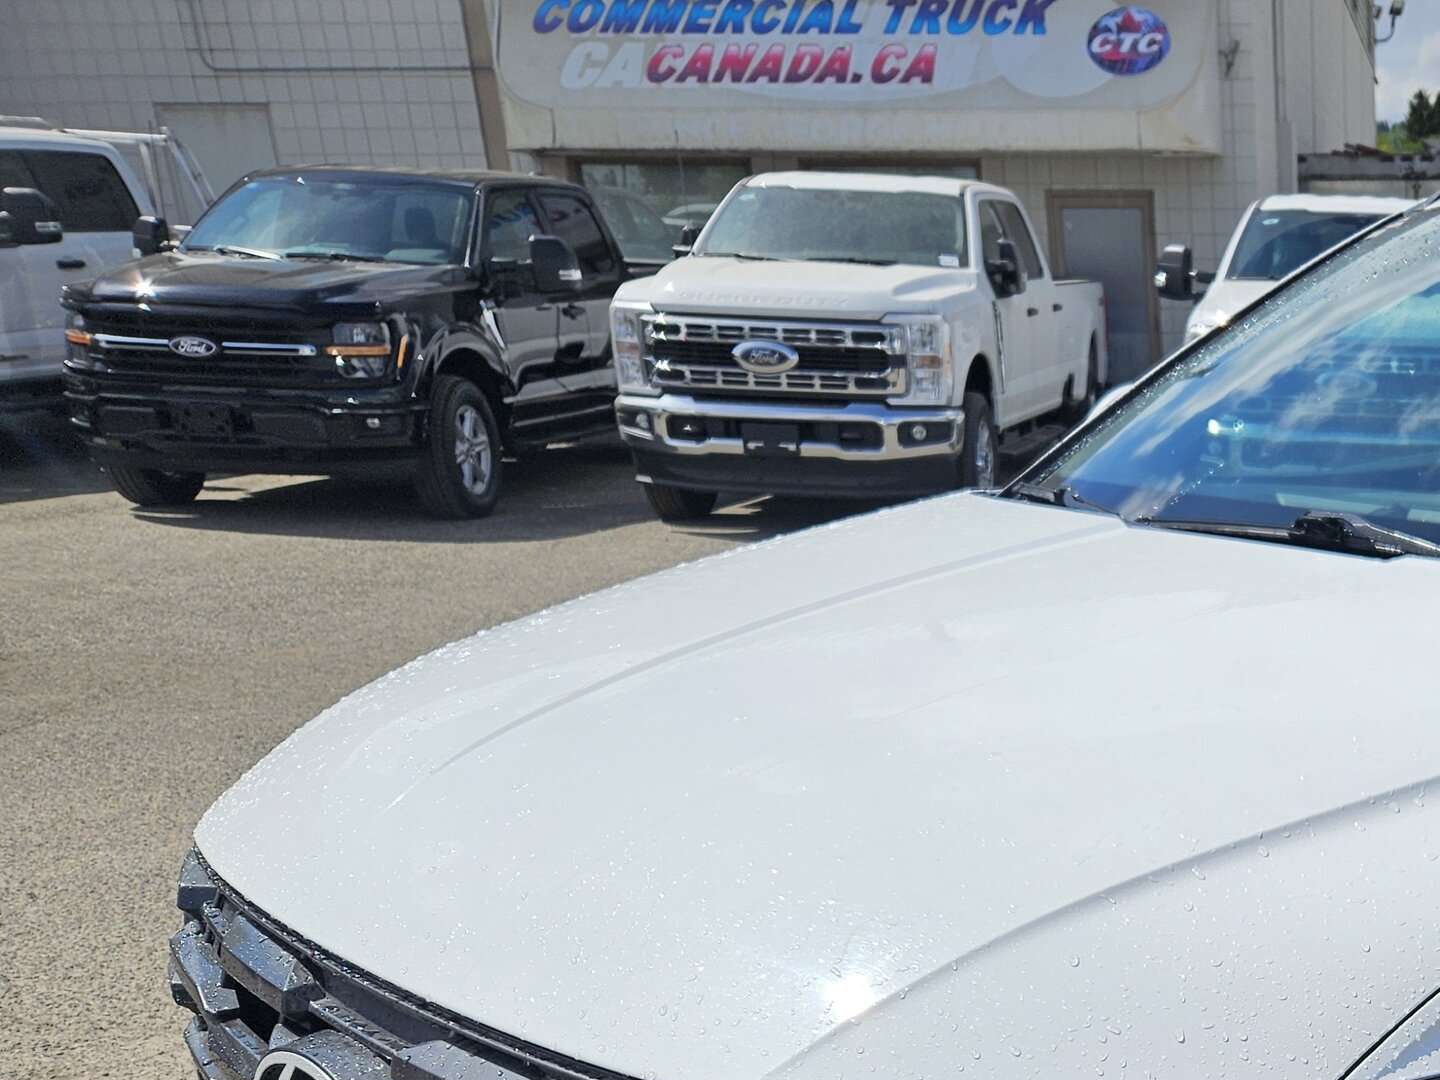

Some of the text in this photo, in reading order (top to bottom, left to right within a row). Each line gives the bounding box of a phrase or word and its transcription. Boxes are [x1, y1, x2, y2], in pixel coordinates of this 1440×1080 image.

[531, 0, 1052, 36] COMMERCIAL TRUCK
[1090, 31, 1164, 54] CTC
[645, 42, 939, 85] CANADA.CA
